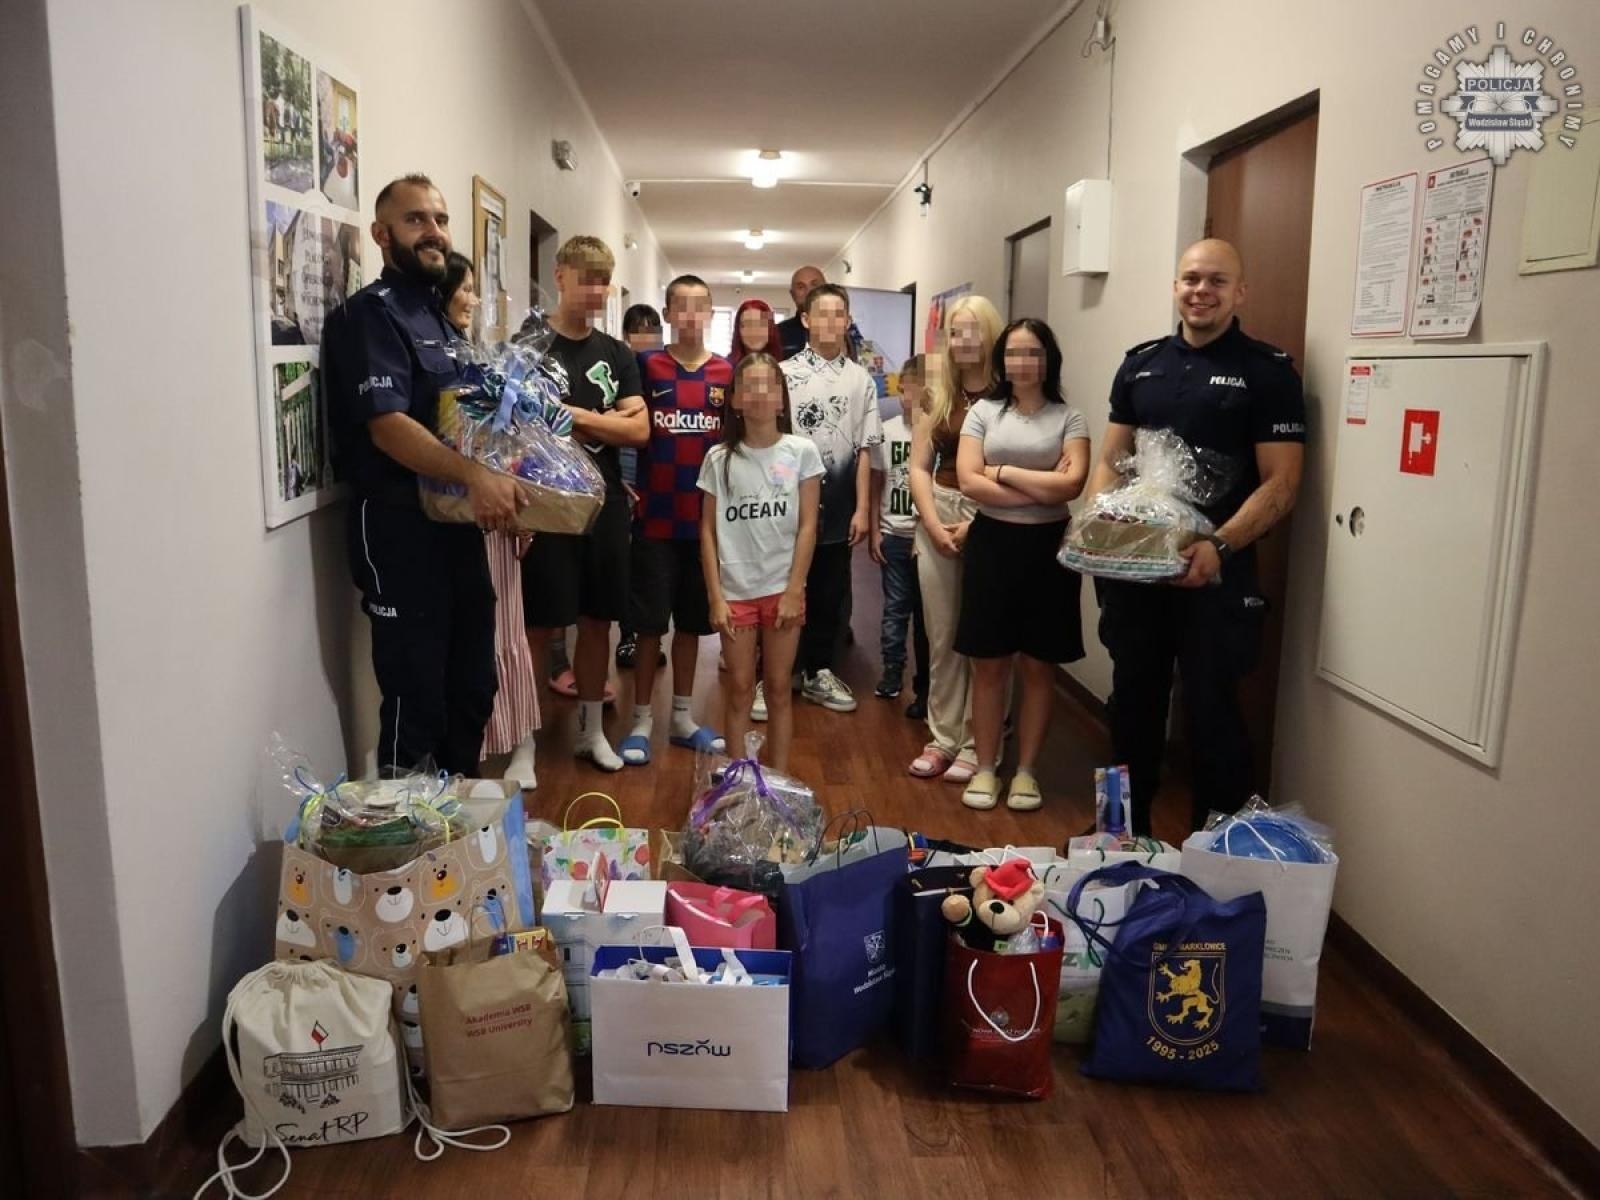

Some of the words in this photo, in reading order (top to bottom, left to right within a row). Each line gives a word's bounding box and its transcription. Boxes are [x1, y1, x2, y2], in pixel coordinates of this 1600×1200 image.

[1209, 376, 1247, 389] POLICJA
[654, 409, 721, 430] Rakuten
[726, 501, 787, 522] OCEAN
[465, 1008, 510, 1025] Akademia
[489, 1017, 533, 1033] University
[1146, 1036, 1177, 1060] 1995
[1187, 1040, 1219, 1060] 2025
[275, 1120, 336, 1142] Senat
[333, 1111, 369, 1137] RP
